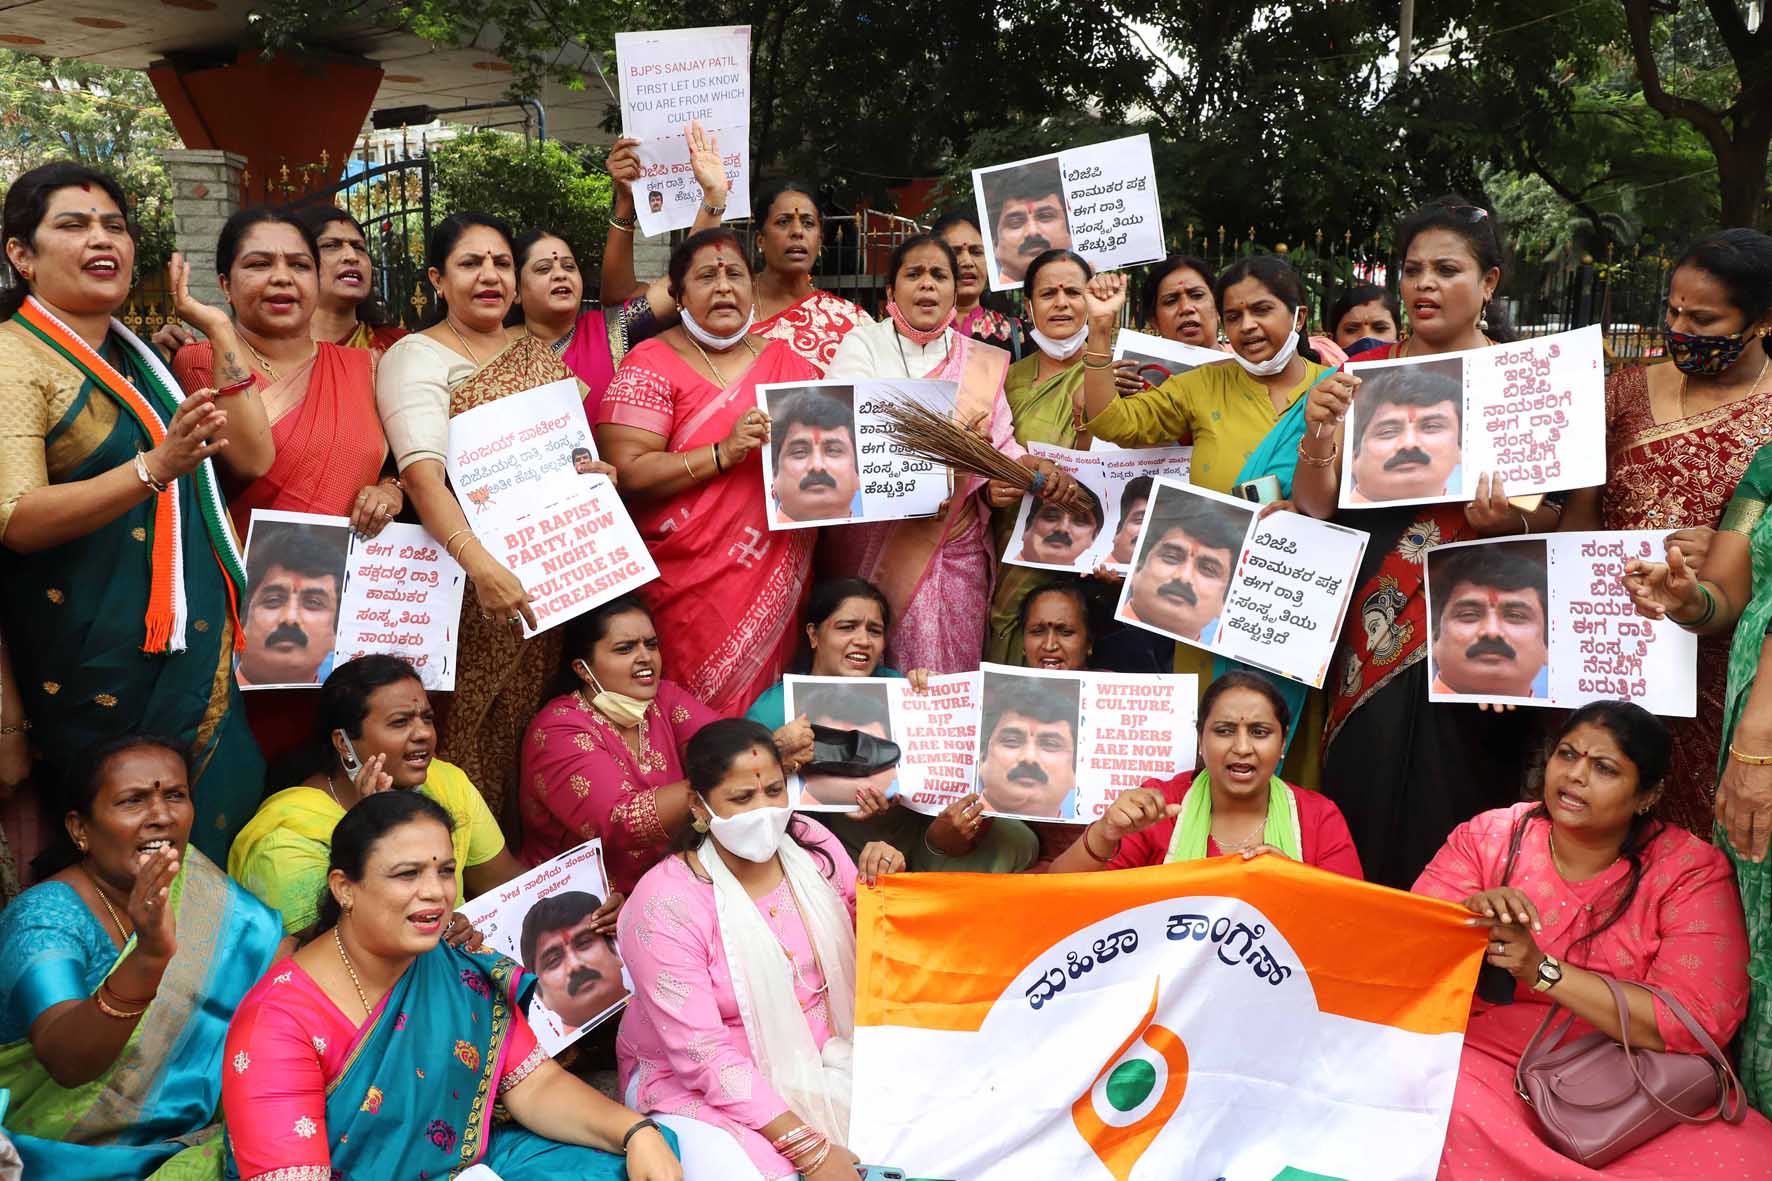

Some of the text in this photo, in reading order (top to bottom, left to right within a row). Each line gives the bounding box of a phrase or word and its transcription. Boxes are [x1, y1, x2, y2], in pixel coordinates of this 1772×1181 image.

[631, 56, 737, 77] BJP'S SANJAY PATIL
[636, 73, 740, 95] FIRST LET US KNOW
[630, 88, 745, 113] YOU ARE FROM WHICH
[667, 109, 713, 124] CULTURE
[1068, 166, 1102, 182] ಬಿಜೆಪಿ
[1071, 176, 1146, 199] ಕಾಮುಕರ ಪಕ್ಷ
[1074, 198, 1125, 216] ಈಗ ರಾತ್ರಿ
[1078, 233, 1127, 252] ಹೆಚ್ಚುತ್ತಿದೆ
[1503, 380, 1551, 398] ಬಿಜೆಪಿ
[1483, 391, 1572, 417] ನಾಯಕರಿಗೆ
[1486, 410, 1569, 432] ಈಗ ರಾತ್ರಿ
[861, 441, 885, 454] ಈಗ
[459, 454, 522, 487] ಬಿಜೆಪಿಯಲ್ಲಿ
[520, 447, 543, 462] ರಾತ್ರಿ
[865, 479, 916, 498] ಹೆಚ್ಚುತ್ತಿದೆ
[504, 498, 600, 549] BJP RAPIST
[506, 511, 614, 569] PARTY, NOW
[1255, 533, 1298, 555] ಬಿಜೆಪಿ
[366, 543, 438, 562] ಈಗ ಬಿಜೆಪಿ
[542, 540, 597, 575] NIGHT
[358, 565, 439, 588] ಪಕ್ಷದಲ್ಲಿ ರಾತ್ರಿ
[527, 545, 629, 601] CULTURE IS
[1249, 555, 1342, 596] ಕಾಮುಕರ ಪಕ್ಷ
[366, 587, 428, 603] ಕಾಮುಕರ
[534, 561, 645, 620] NCREASING.
[1243, 575, 1305, 608] ಈಗ ರಾತ್ರಿ
[357, 631, 424, 646] ನಾಯಕರು
[1228, 616, 1291, 645] ಹೆಚ್ಚುತ್ತಿದೆ
[1573, 617, 1656, 643] ಈಗ ರಾತ್ರಿ
[1097, 684, 1174, 696] WITHOUT
[1578, 677, 1646, 701] ಬರುತ್ತಿದೆ
[902, 696, 974, 710] CULTURE,
[1096, 699, 1174, 714] CULTURE,
[928, 713, 952, 726] BJP
[1120, 714, 1148, 728] BJP
[907, 725, 976, 737] LEADERS
[1096, 728, 1172, 742] LEADERS
[908, 740, 975, 752] ARE NOW
[1094, 744, 1173, 757] ARE NOW
[928, 766, 964, 778] RING
[1090, 758, 1175, 773] REMEMBE
[924, 779, 969, 793] NIGHT
[1025, 914, 1291, 1010] ಮಹಿಳಾ ಕಾಂಗ್ರೆಸ್
